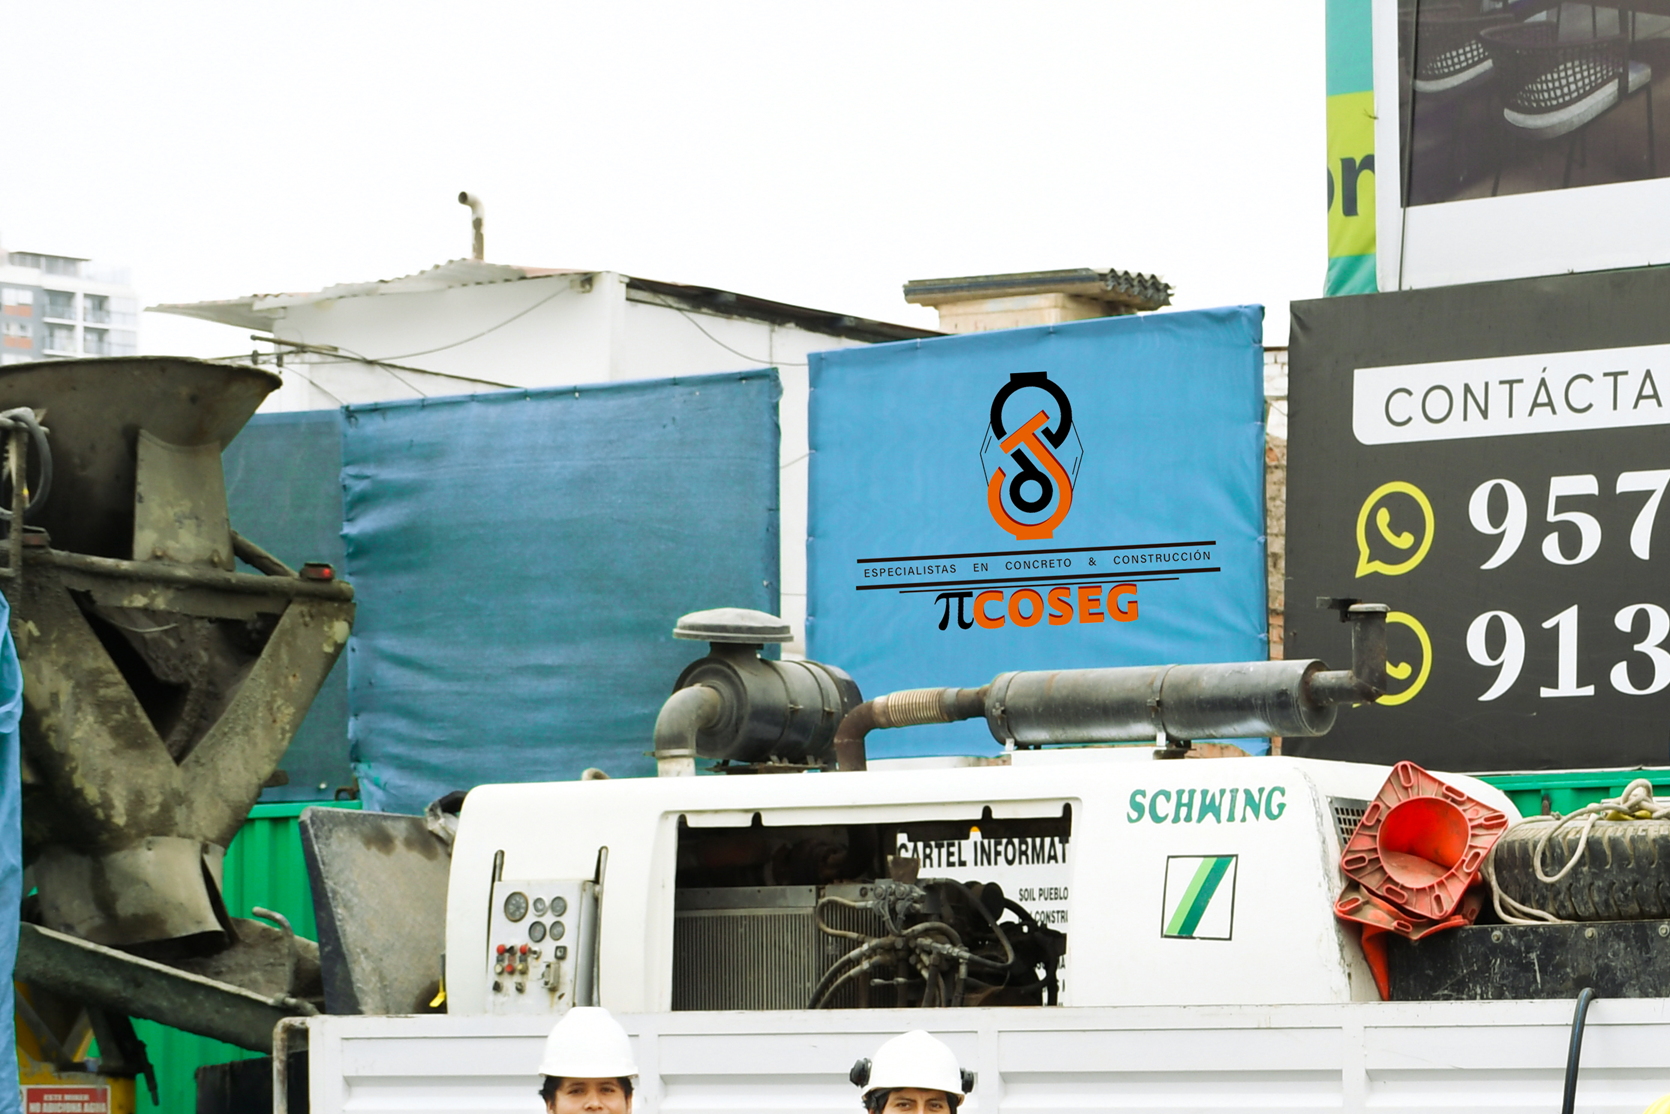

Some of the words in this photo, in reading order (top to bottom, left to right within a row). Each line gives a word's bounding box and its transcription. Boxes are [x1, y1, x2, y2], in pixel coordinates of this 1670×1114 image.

[864, 563, 957, 578] ESPECIALISTAS
[973, 562, 989, 573] EN
[1005, 558, 1072, 571] CONCRETO
[1088, 556, 1097, 567] &
[1113, 549, 1211, 565] CONSTRUCCIÓN
[1127, 786, 1287, 824] SCHWING
[1018, 887, 1036, 902] SOIL
[1038, 886, 1069, 901] PUEBLO
